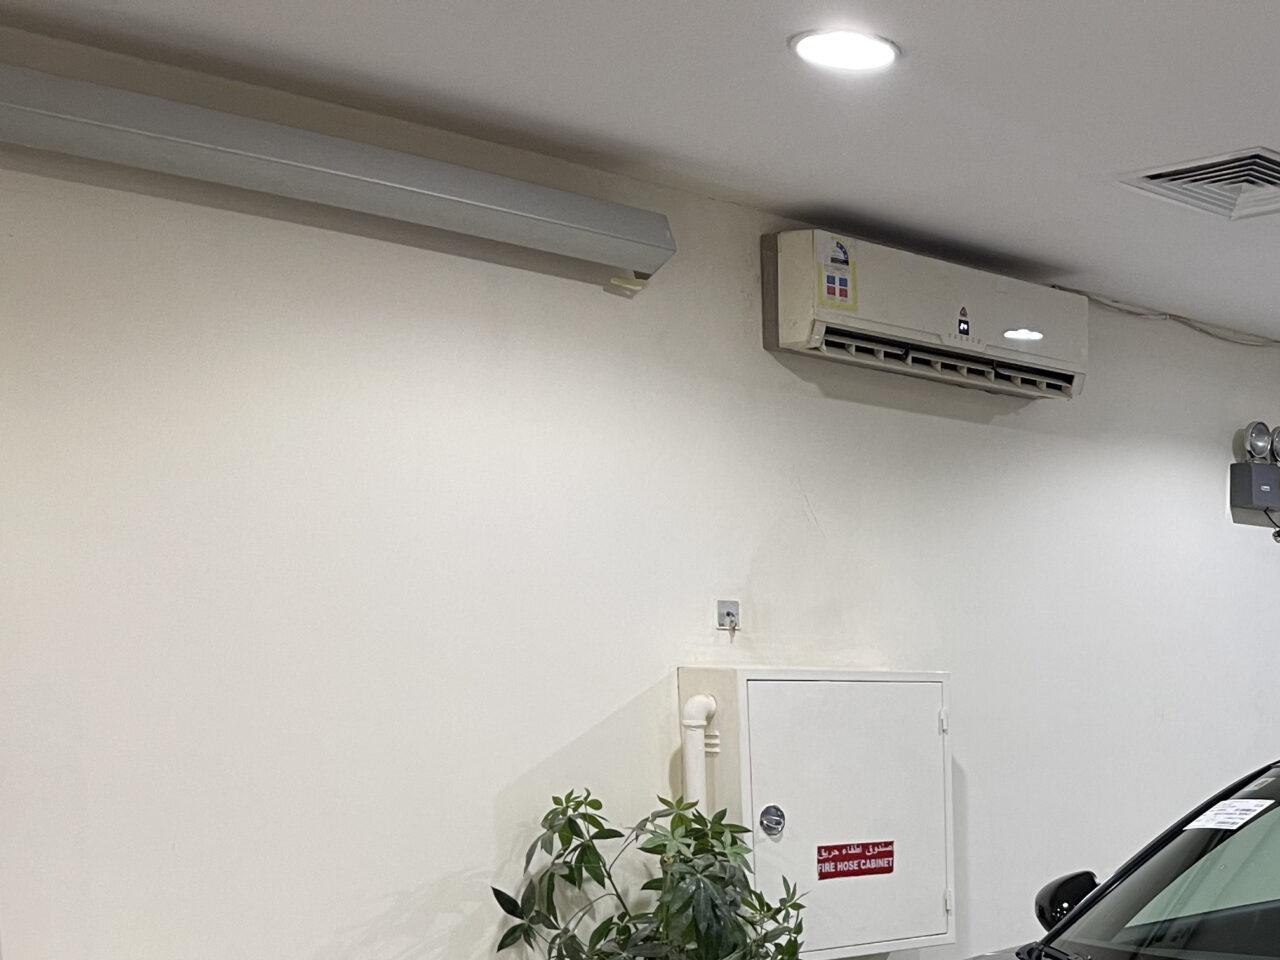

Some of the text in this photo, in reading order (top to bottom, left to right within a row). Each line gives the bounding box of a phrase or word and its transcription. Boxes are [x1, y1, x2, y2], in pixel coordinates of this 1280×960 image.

[817, 857, 893, 873] FIRE HOSE CABINET
